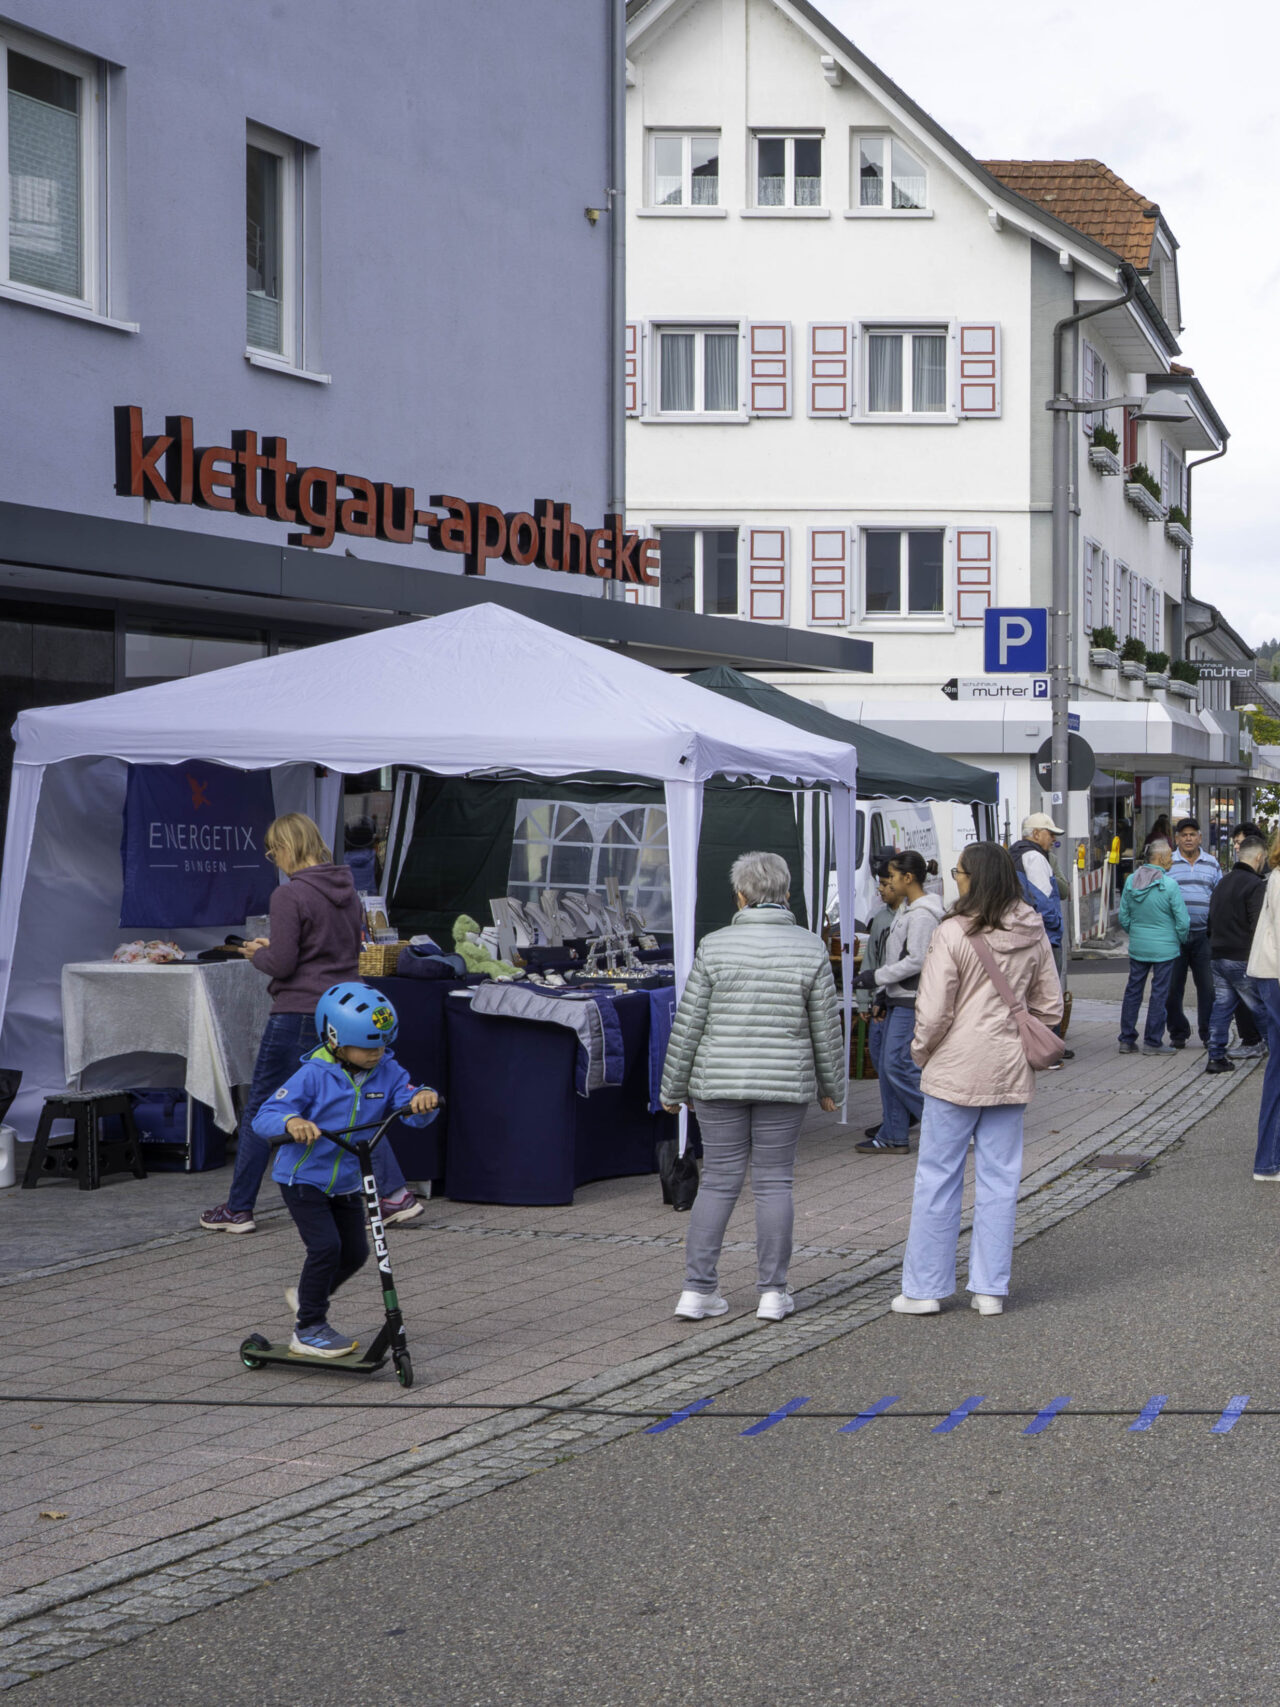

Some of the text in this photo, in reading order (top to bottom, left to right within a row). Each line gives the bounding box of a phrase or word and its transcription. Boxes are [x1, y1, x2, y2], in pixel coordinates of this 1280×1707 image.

[114, 405, 660, 587] klettgau-apotheke
[999, 616, 1033, 665] P
[1199, 666, 1253, 678] mutter
[972, 685, 1029, 697] mutter
[1035, 681, 1046, 696] P
[149, 822, 257, 851] ENERGETIX
[184, 860, 227, 873] BINGEN
[363, 1174, 393, 1274] APOLLO
